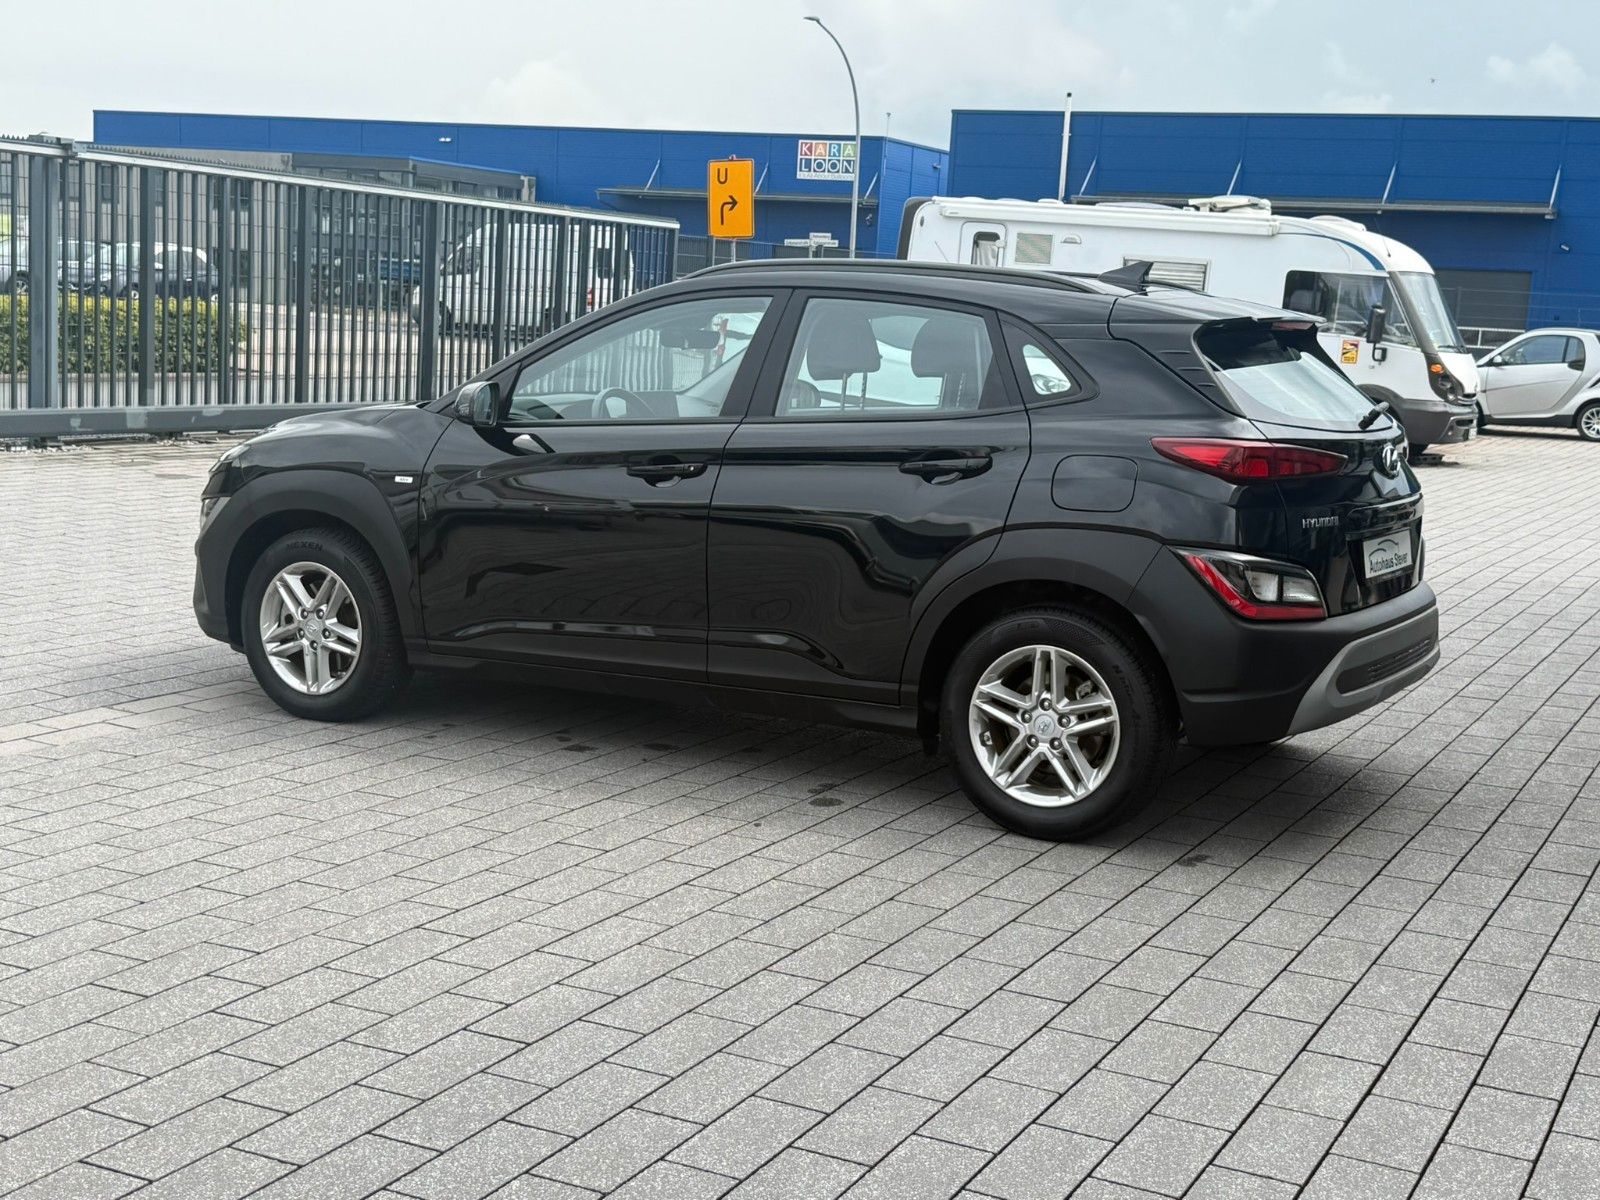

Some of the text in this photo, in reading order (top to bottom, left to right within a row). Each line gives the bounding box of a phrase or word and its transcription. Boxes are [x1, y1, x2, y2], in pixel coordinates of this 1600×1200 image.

[802, 143, 854, 157] KARA
[802, 159, 853, 173] LOON
[717, 168, 728, 184] U
[1370, 557, 1394, 574] Autohaus
